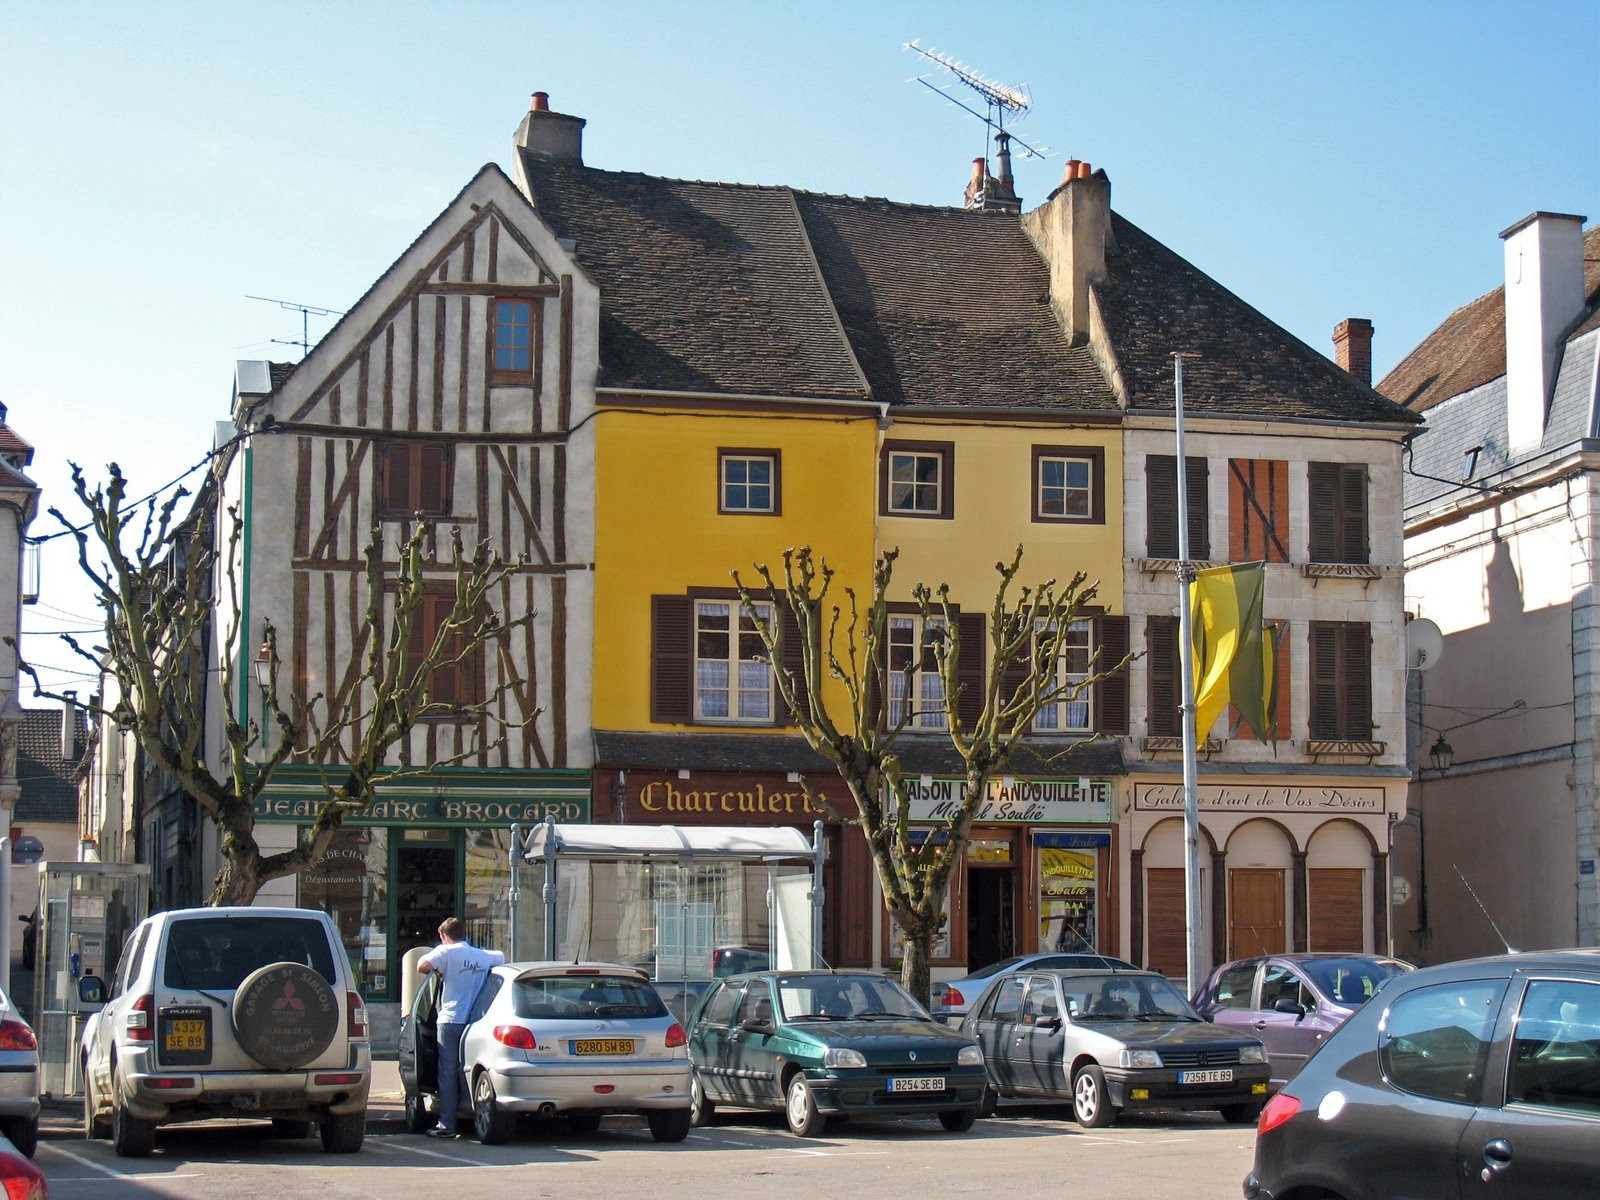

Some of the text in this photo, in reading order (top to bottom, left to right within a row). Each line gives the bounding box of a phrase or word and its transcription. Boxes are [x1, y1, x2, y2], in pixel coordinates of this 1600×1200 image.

[986, 782, 1106, 803] L'ANDOUILLETTE
[1144, 786, 1375, 808] Galee d'art de Vos Désirs
[441, 800, 582, 822] BROCARD
[326, 849, 341, 859] DE
[1042, 865, 1094, 879] ANDOUILLETTES
[246, 974, 276, 1017] GARAGE
[174, 1021, 203, 1034] 4337
[169, 1036, 202, 1048] SE 89
[576, 1041, 632, 1053] 6280 SW 89
[1185, 1070, 1232, 1083] 7358 TE 89
[895, 1079, 944, 1091] 8254 SE 89
